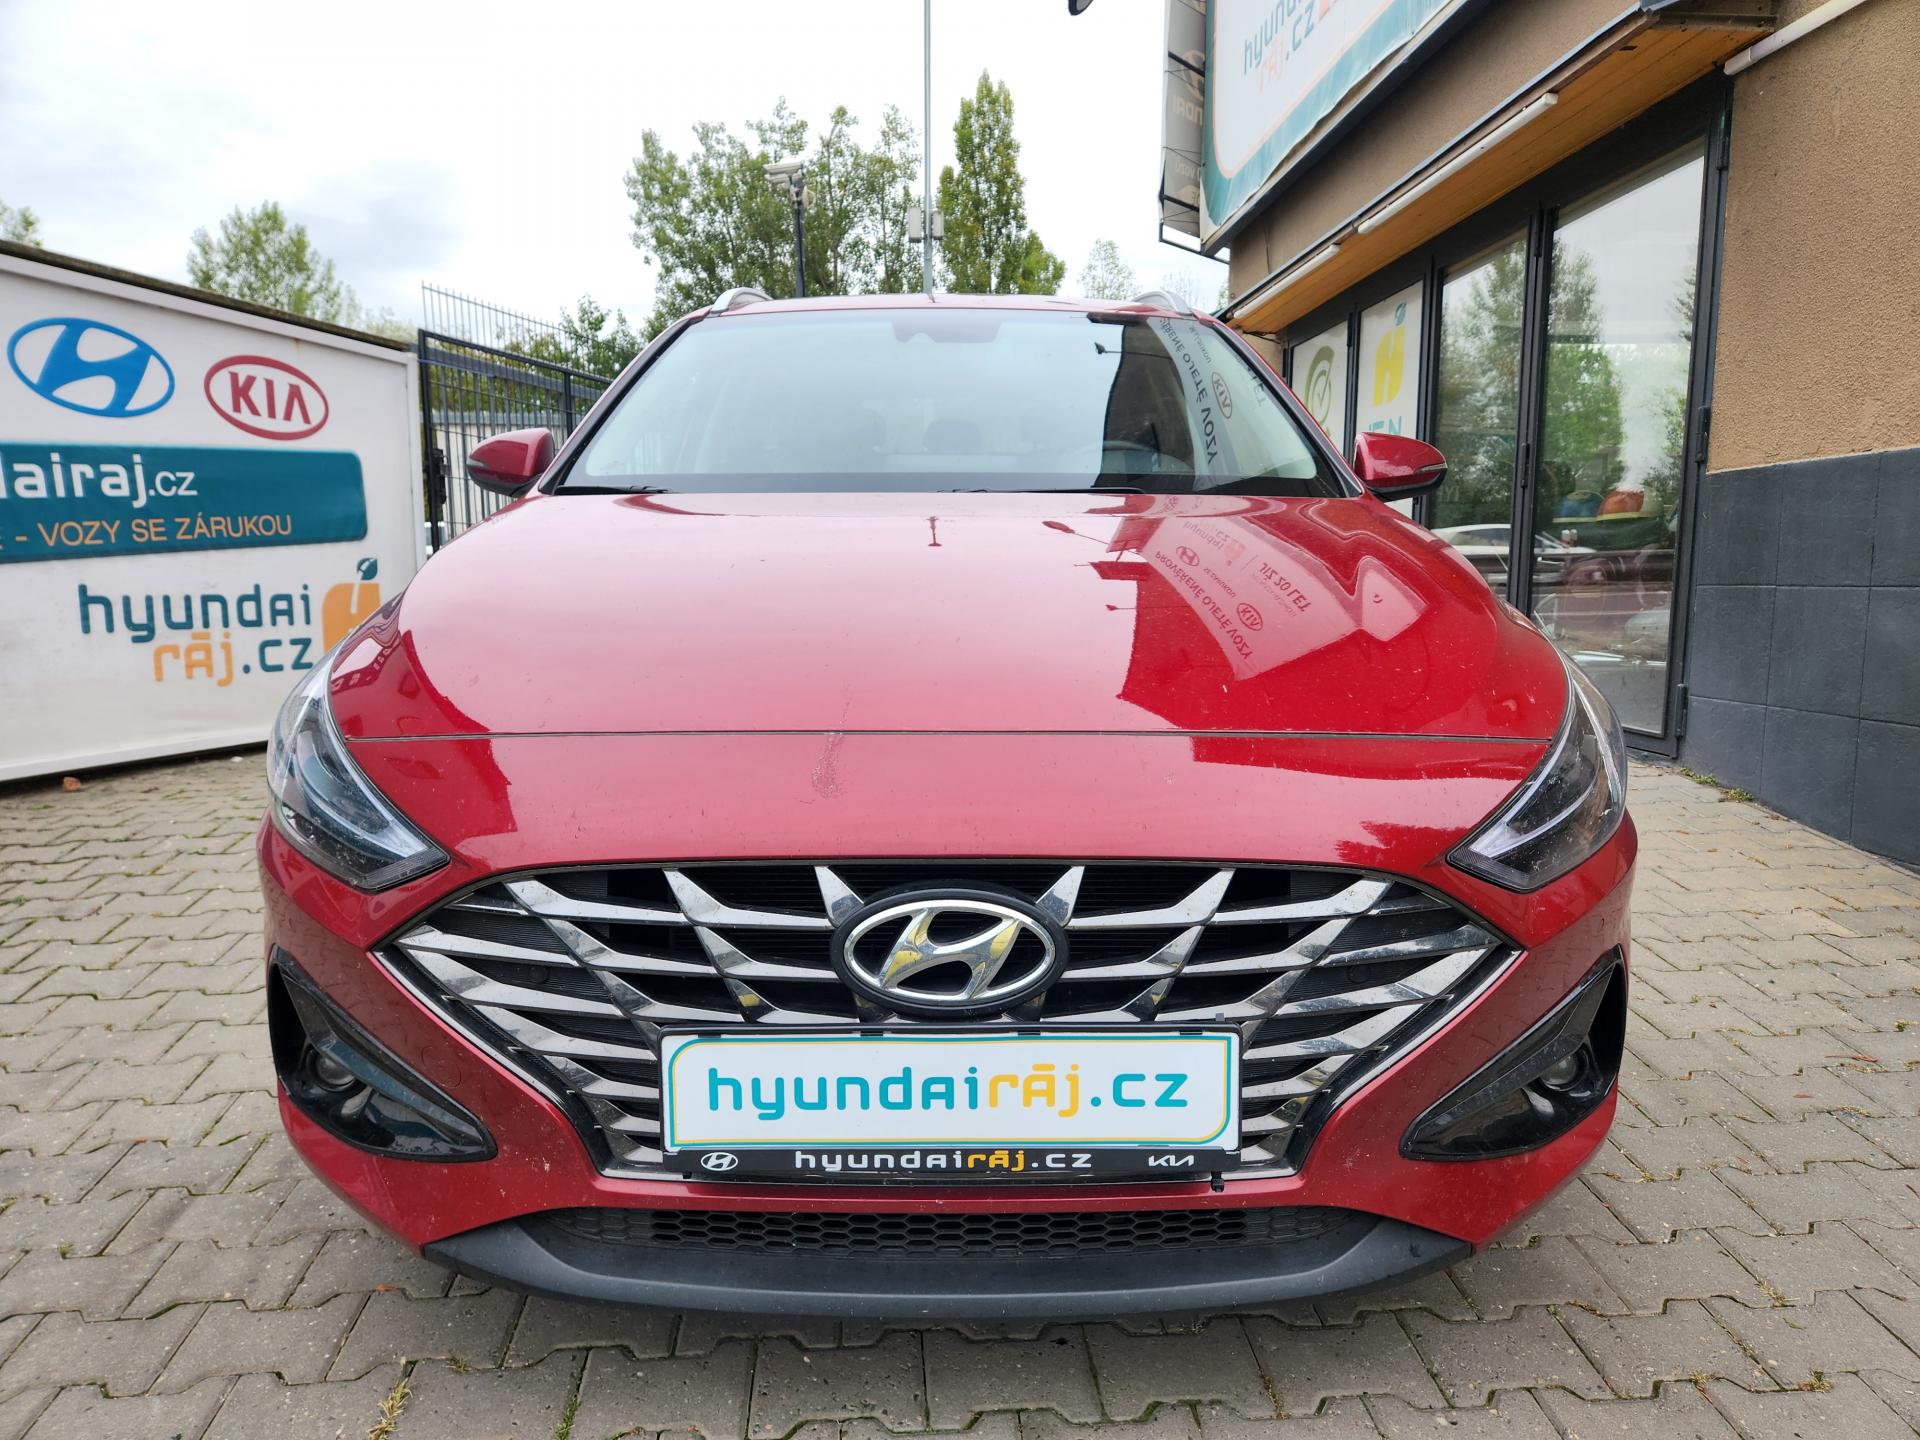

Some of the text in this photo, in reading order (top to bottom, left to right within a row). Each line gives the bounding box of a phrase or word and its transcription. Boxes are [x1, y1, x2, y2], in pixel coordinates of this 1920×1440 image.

[228, 371, 312, 425] KIA
[37, 520, 121, 547] VOZY
[131, 518, 167, 542] SE
[175, 512, 293, 541] ZÁRUKOU
[78, 583, 312, 644] hyundai
[1148, 1154, 1195, 1167] KIA
